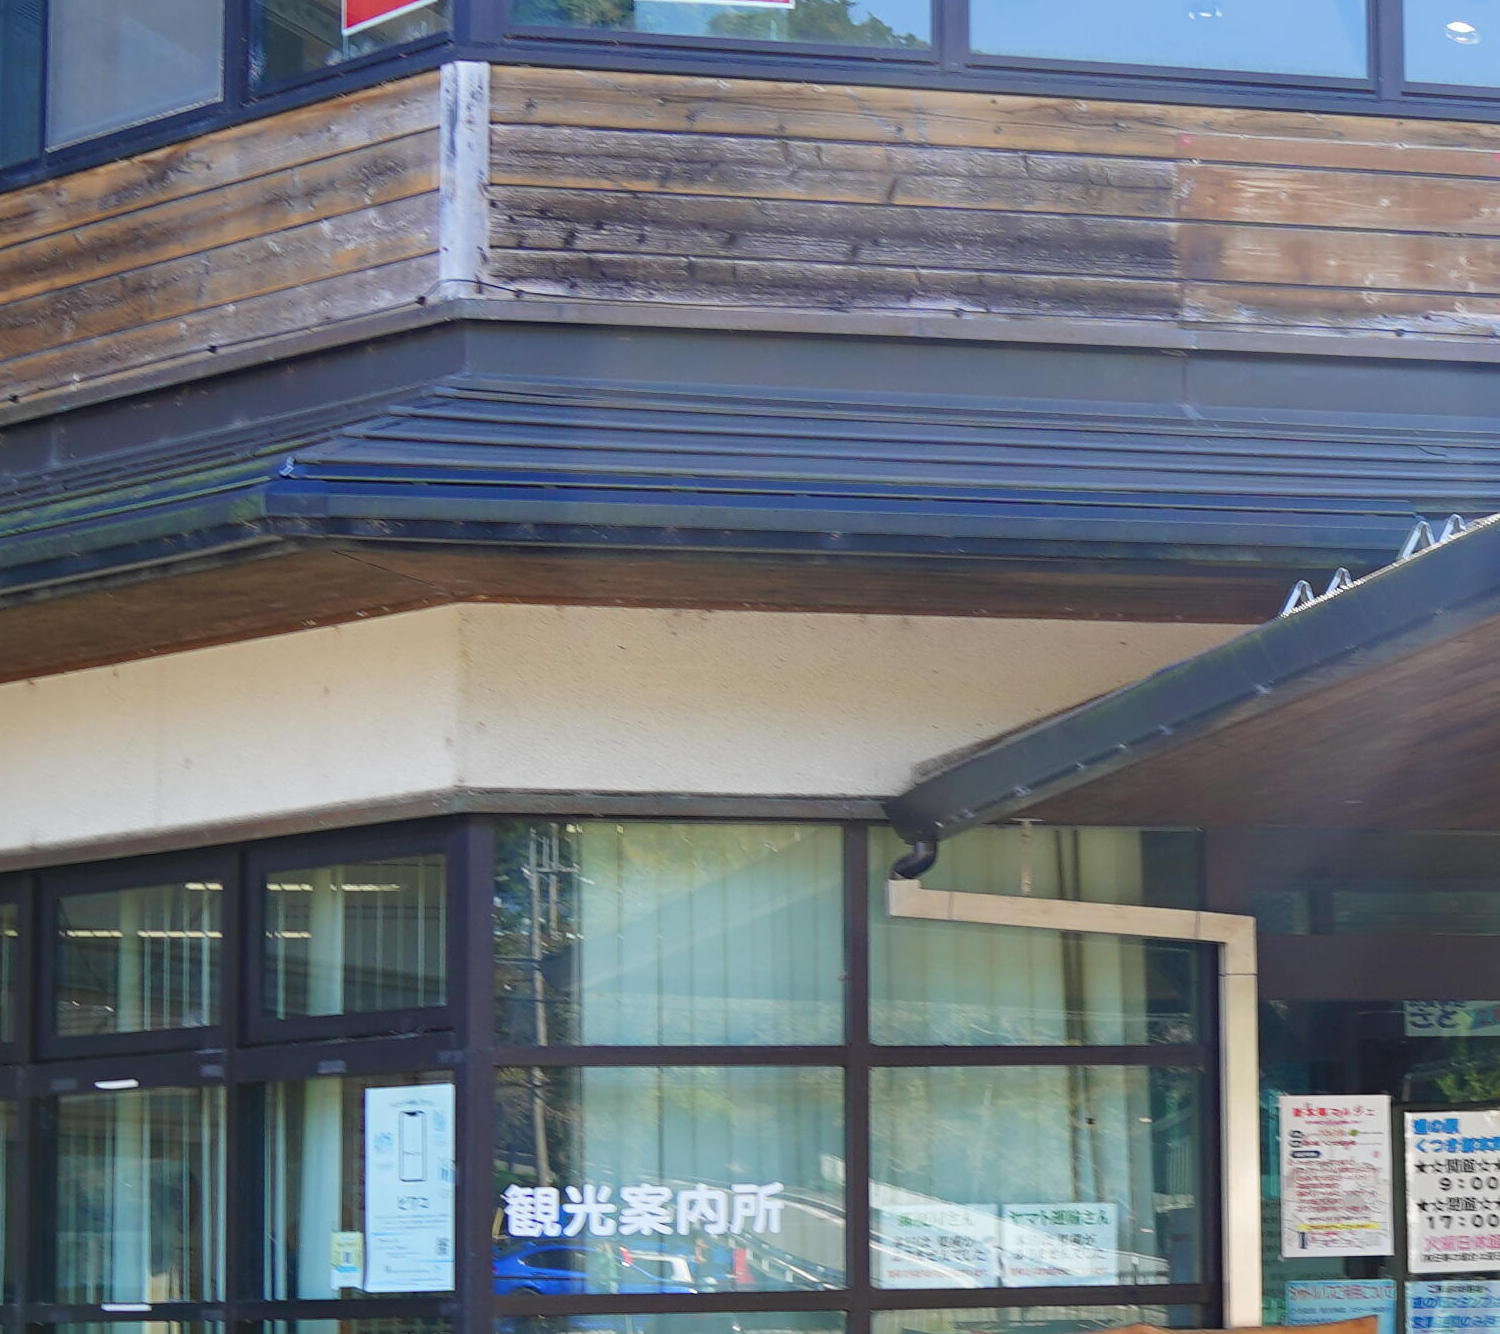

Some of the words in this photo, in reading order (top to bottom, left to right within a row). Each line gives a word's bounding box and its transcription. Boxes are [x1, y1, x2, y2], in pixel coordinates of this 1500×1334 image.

[1438, 1176, 1500, 1191] 9:00
[504, 1182, 786, 1237] 観光案内所
